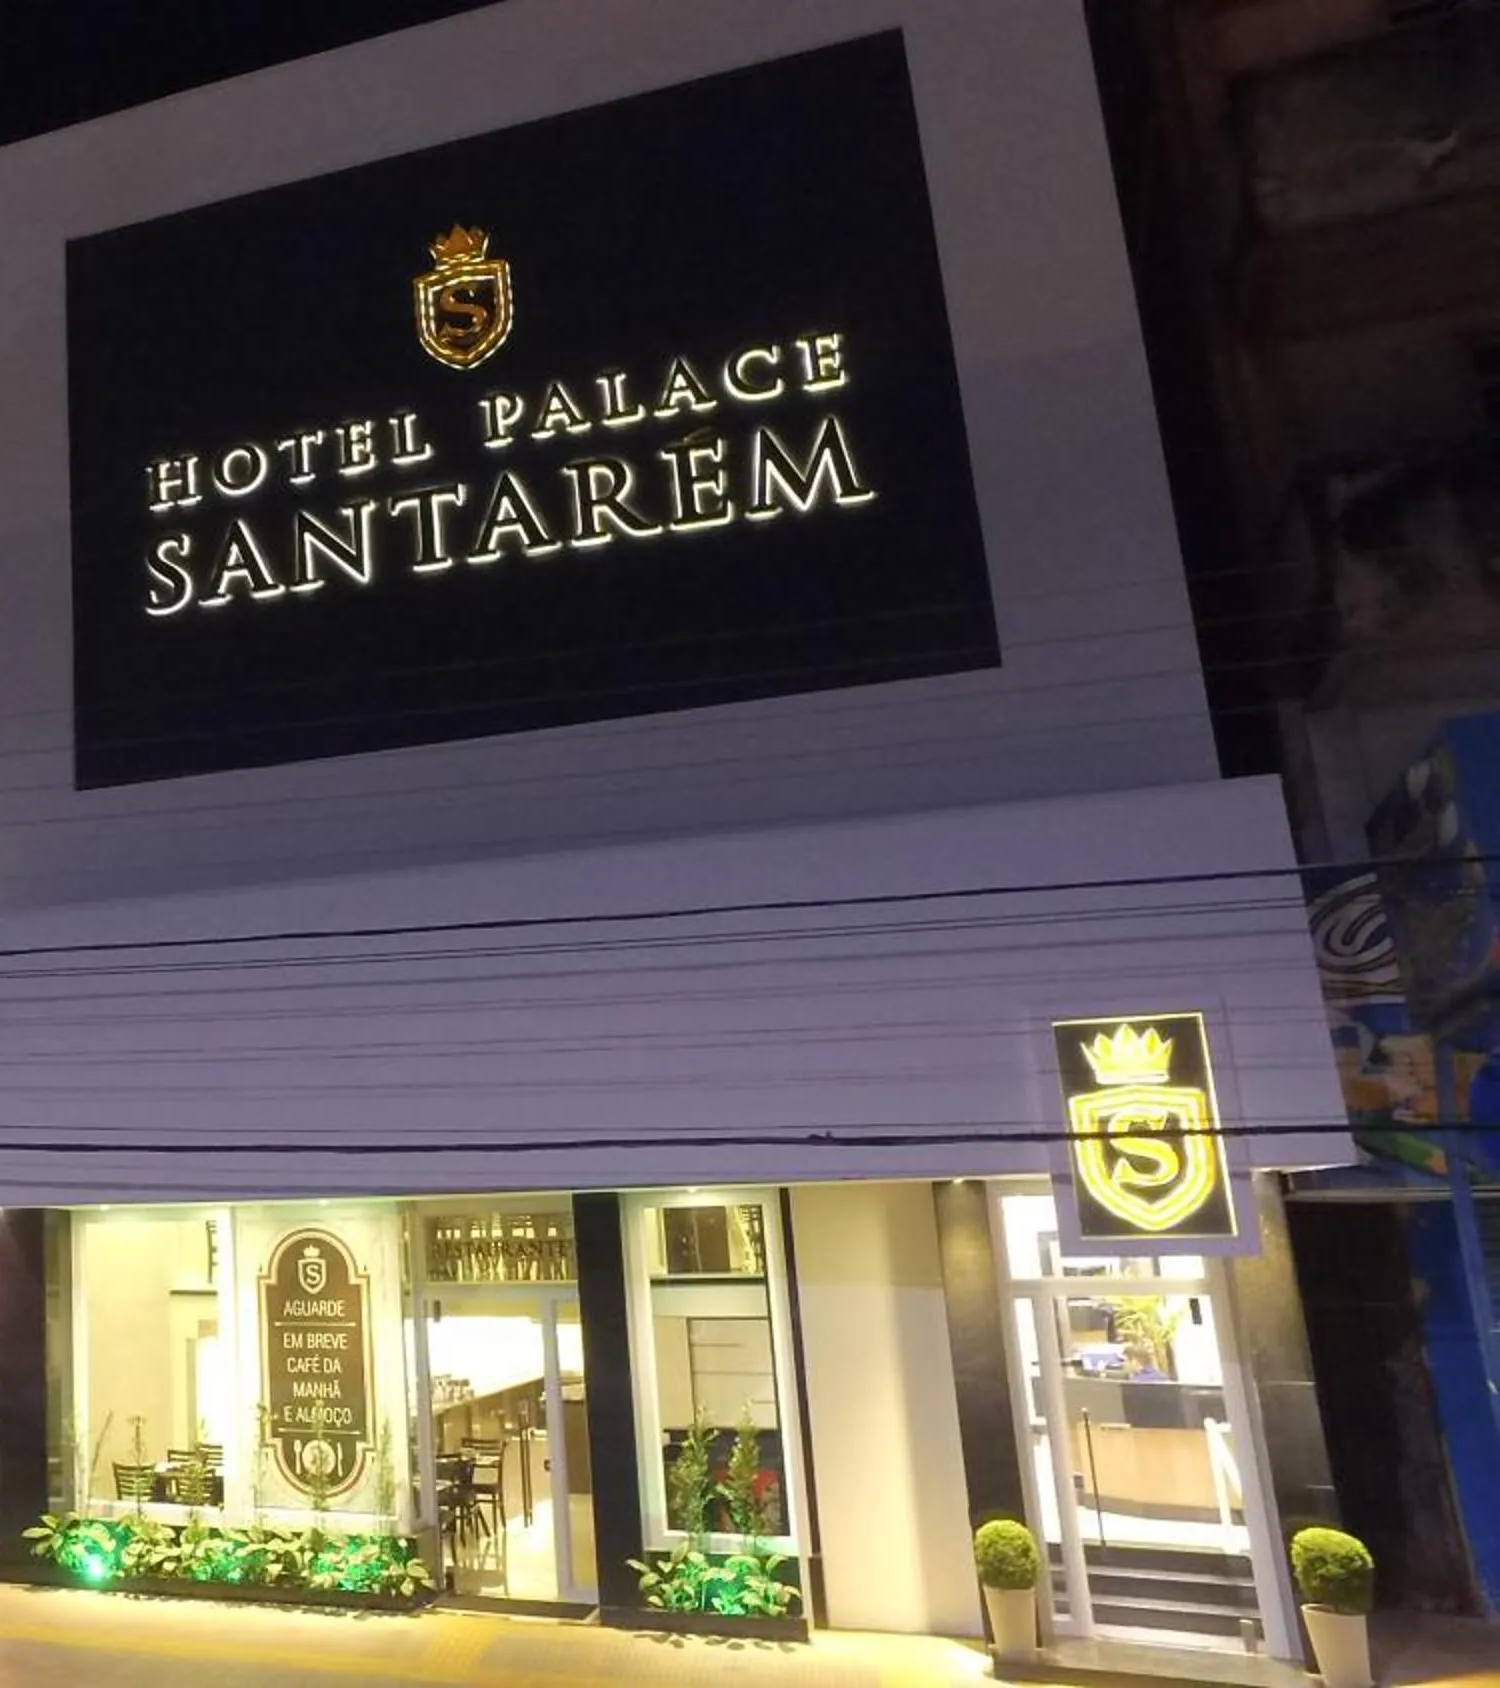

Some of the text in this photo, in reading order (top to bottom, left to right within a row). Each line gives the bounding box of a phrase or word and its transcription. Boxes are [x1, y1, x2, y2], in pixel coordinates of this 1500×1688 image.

[439, 284, 487, 344] S
[146, 332, 850, 511] HOTEL PALACE
[1107, 1107, 1179, 1187] S
[305, 1263, 321, 1285] S
[283, 1299, 346, 1317] AGUARDE
[283, 1332, 349, 1350] EM BREVE
[286, 1353, 343, 1374] CAFÉ DA
[293, 1378, 342, 1399] MANHÃ
[283, 1405, 294, 1423] E
